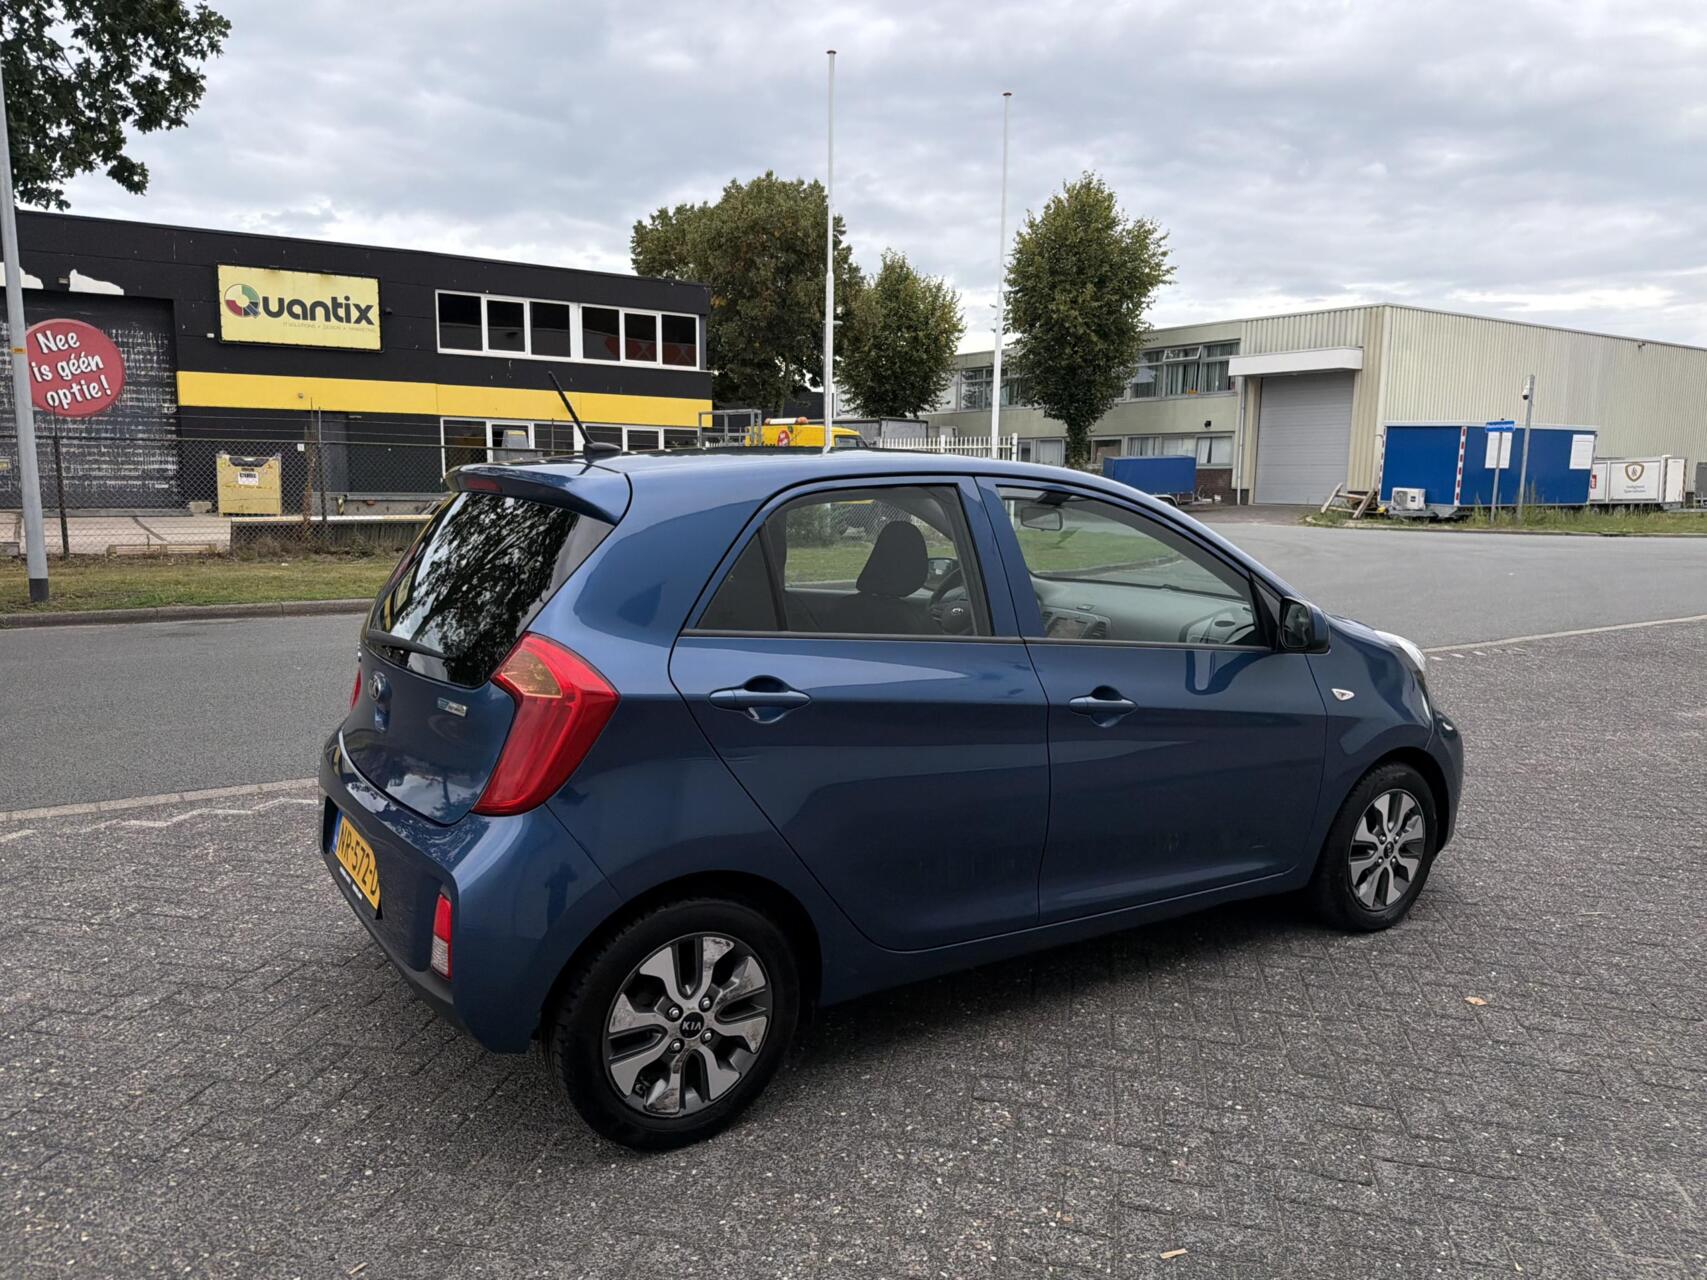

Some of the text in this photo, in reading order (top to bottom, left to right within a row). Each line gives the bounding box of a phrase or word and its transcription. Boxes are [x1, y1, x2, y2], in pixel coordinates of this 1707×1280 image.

[224, 284, 375, 326] Quantix
[35, 330, 80, 354] Nee
[30, 352, 104, 382] is géén
[46, 374, 111, 409] optie!
[682, 1020, 701, 1030] KIA
